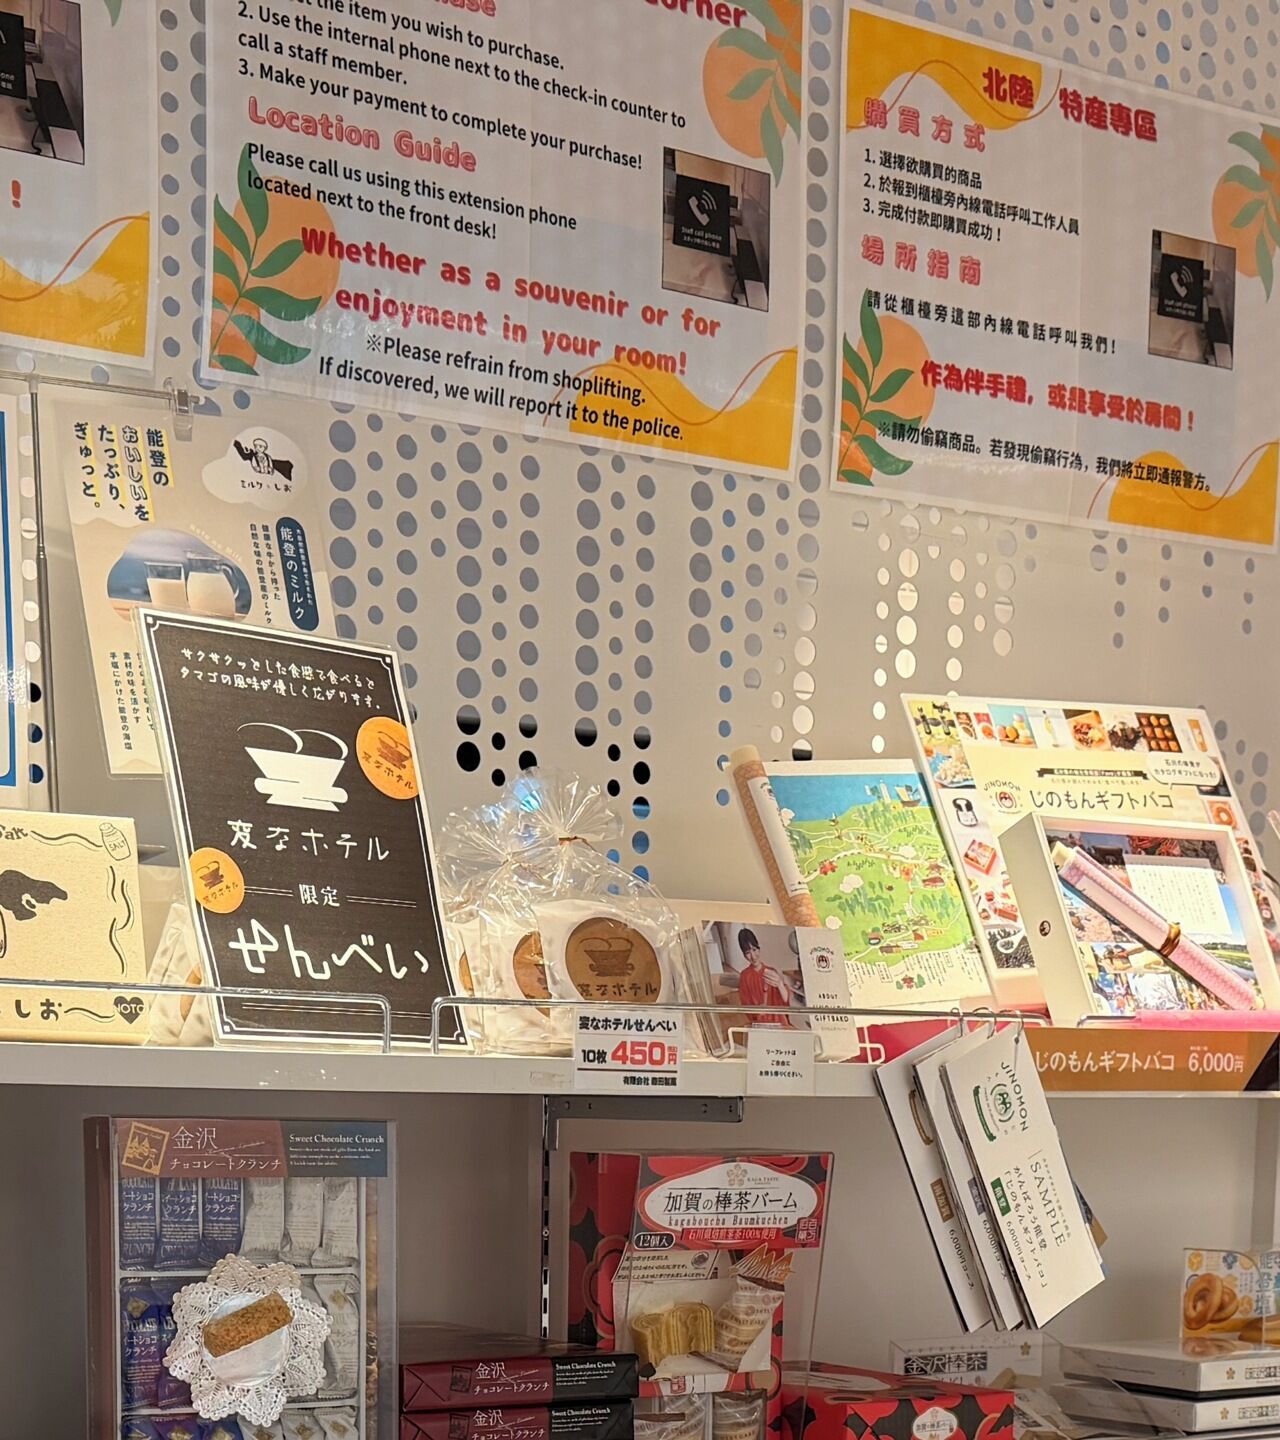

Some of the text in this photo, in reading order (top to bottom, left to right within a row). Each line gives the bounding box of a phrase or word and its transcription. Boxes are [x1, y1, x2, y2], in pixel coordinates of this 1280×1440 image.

[238, 31, 408, 85] call a staff member.
[349, 2, 387, 24] item
[391, 13, 422, 32] you
[425, 20, 463, 44] wish
[468, 31, 484, 48] to
[488, 37, 565, 70] purchase.
[237, 1, 686, 129] 2. Use the internal phone next to the check-in counter to
[982, 67, 1035, 109] 北陸
[238, 59, 643, 170] 3. Make your payment to complete your purchase!
[247, 96, 477, 172] Location Guide
[247, 142, 577, 230] Please call us using this extension phone
[879, 150, 983, 189] 選擇欲購買的商品
[247, 170, 497, 240] located next to the front desk!
[301, 226, 721, 338] Whether as a souvenir or for
[335, 287, 688, 376] enjoyment in your room!
[319, 355, 684, 441] If discovered, we will report it to the police.
[446, 350, 504, 376] refrain
[508, 361, 549, 385] from
[552, 370, 646, 405] shoplifting.
[122, 425, 150, 521] おいしいを
[146, 428, 170, 487] 能登の
[279, 526, 305, 622] 能登のミルク
[181, 648, 376, 690] サクサクッとした食感で食べると
[1028, 788, 1174, 811] じのもんギフトバコ
[227, 819, 390, 863] 変なホテル
[298, 884, 340, 906] 限定
[228, 919, 431, 980] せんべい
[578, 1016, 677, 1031] 変なホテルせんべい
[581, 1049, 608, 1064] 10枚
[1034, 1049, 1175, 1075] じのもんギフトバコ
[172, 1127, 218, 1150] 金沢
[290, 1134, 385, 1145] Sweet Chocolate Crunch
[169, 1156, 283, 1172] チョコレートクランチ
[664, 1191, 799, 1213] 加賀の棒茶バーム
[1030, 1160, 1066, 1248] SAMPLE
[637, 1234, 670, 1248] 12個入
[474, 1381, 550, 1396] チョコレートクランチ
[475, 1362, 507, 1379] 金沢
